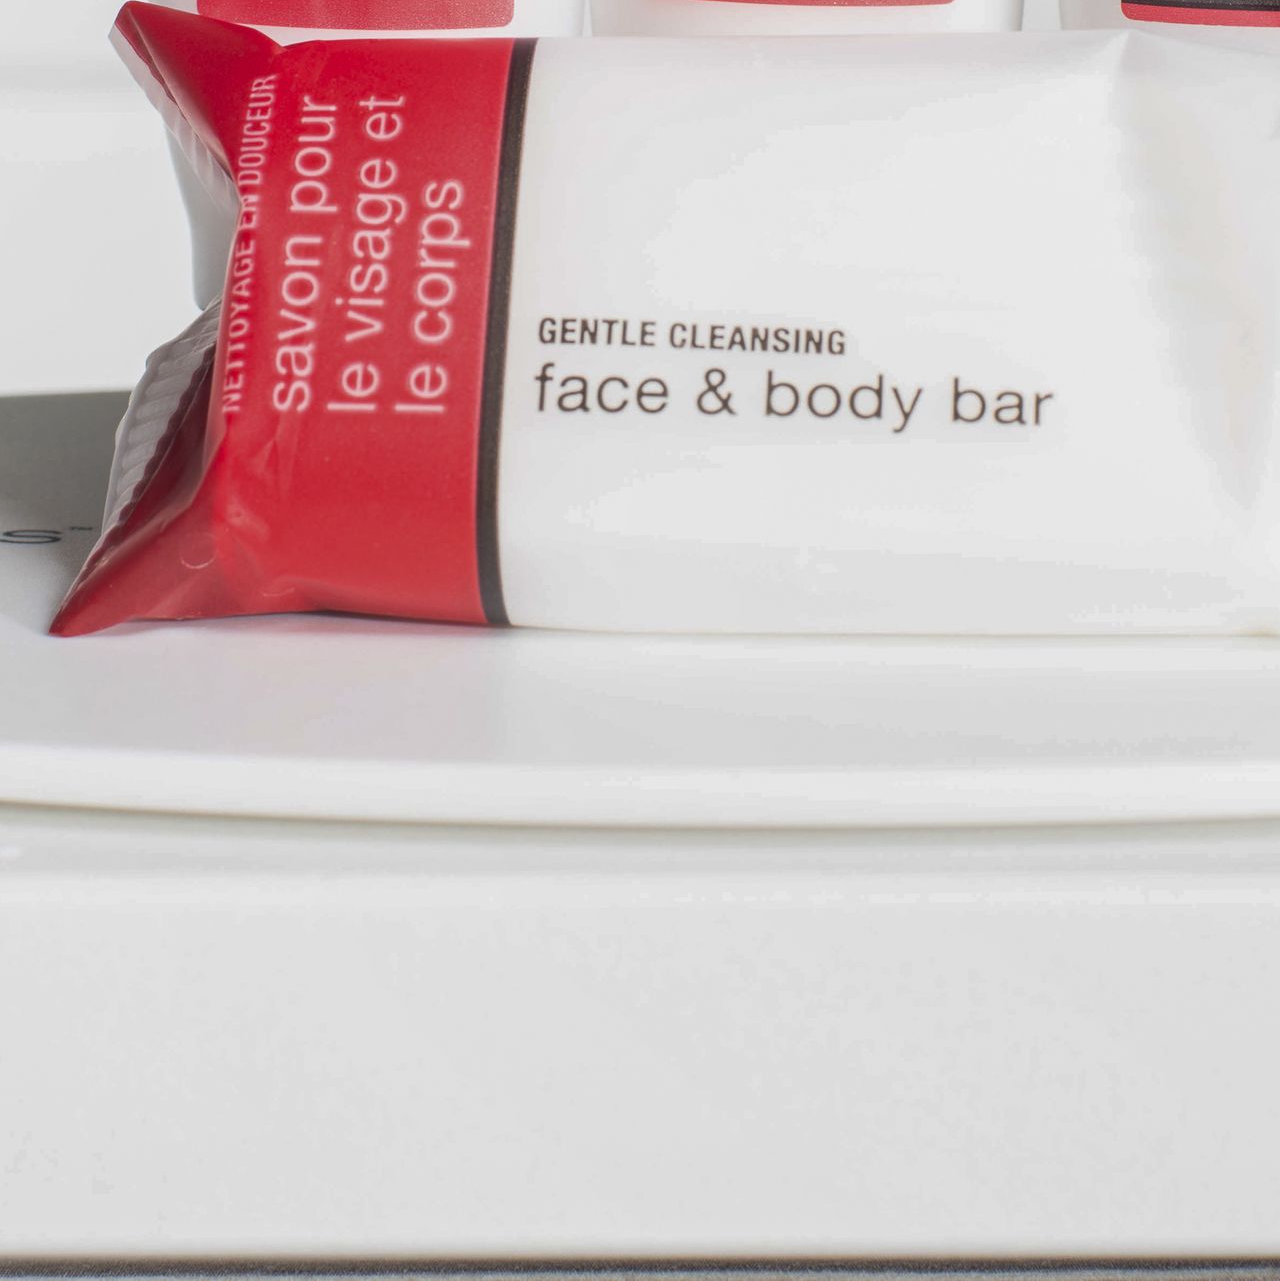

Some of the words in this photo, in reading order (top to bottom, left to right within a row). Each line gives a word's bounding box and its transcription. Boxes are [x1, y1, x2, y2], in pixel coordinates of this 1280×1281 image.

[237, 74, 277, 186] DOUCEUR
[289, 94, 338, 214] pour
[358, 93, 405, 141] et
[334, 156, 408, 341] visage
[413, 179, 472, 345] corps
[222, 239, 257, 413] NETTOYAGE
[273, 234, 325, 414] savon
[537, 317, 657, 347] GENTLE
[668, 322, 848, 355] CLEANSING
[327, 361, 381, 414] le
[394, 364, 449, 414] le
[535, 362, 669, 414] face
[696, 367, 739, 417] &
[765, 369, 924, 433] body
[951, 376, 1055, 426] bar
